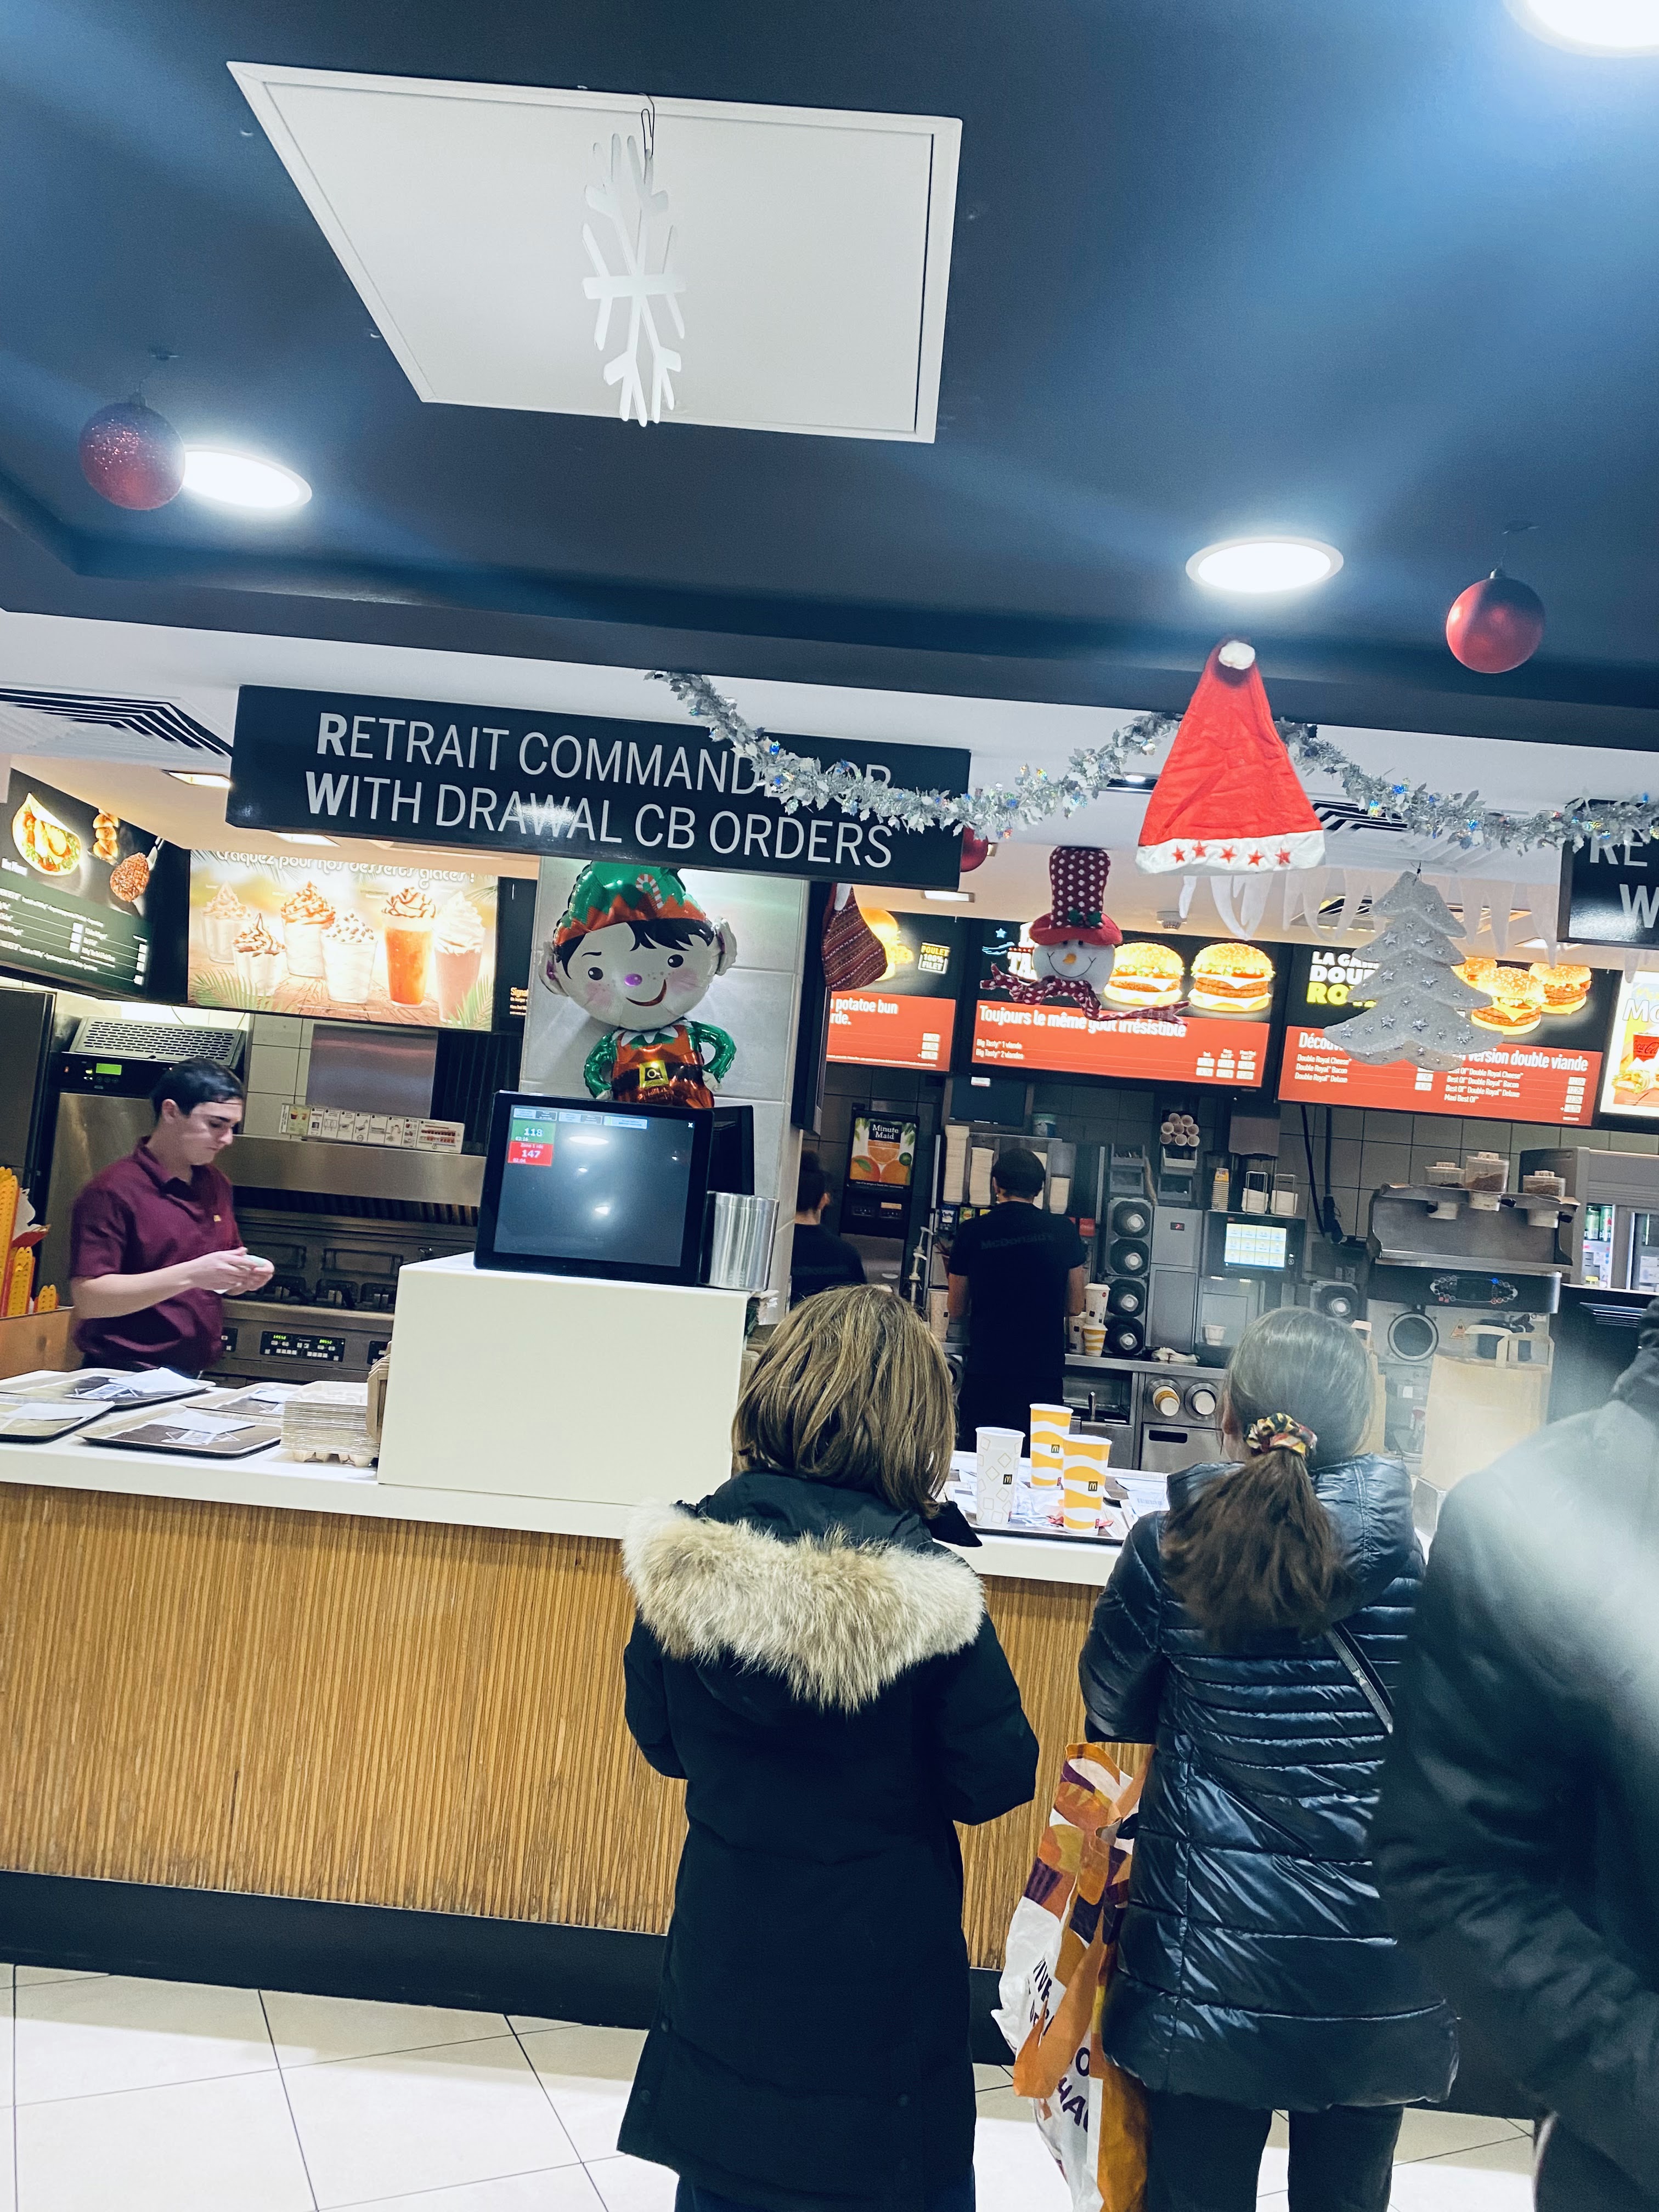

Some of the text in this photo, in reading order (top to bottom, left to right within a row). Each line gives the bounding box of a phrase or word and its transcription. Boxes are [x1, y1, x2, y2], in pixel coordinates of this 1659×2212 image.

[317, 712, 509, 771] RETRAIT
[306, 771, 893, 868] WITH DRAWAL CB ORDERS
[279, 856, 312, 869] pour
[318, 859, 342, 874] nos
[921, 945, 950, 957] POULET
[923, 953, 944, 963] 100%
[1312, 951, 1335, 966] LA
[922, 961, 943, 970] FILET
[836, 997, 876, 1013] potatoe
[878, 999, 899, 1014] bun
[979, 1005, 1032, 1026] Toujours
[1033, 1009, 1046, 1026] le
[1047, 1011, 1087, 1030] même
[977, 1039, 985, 1048] Big
[1006, 1041, 1023, 1049] viande
[975, 1048, 984, 1058] Big
[1005, 1051, 1024, 1060] viandes
[1297, 1054, 1316, 1063] Double
[1469, 1047, 1509, 1065] version
[1510, 1049, 1549, 1069] double
[1551, 1053, 1588, 1072] viande
[1296, 1063, 1314, 1071] Double
[1331, 1066, 1348, 1074] Bacon
[1469, 1068, 1487, 1076] Double
[1295, 1072, 1313, 1080] Double
[1447, 1075, 1459, 1083] Best
[1468, 1077, 1486, 1085] Double
[1503, 1080, 1519, 1088] Bacon
[1468, 1086, 1485, 1094] Double
[1502, 1089, 1520, 1097] Deluxe
[524, 1127, 543, 1137] 118
[872, 1124, 899, 1133] Minute
[875, 1131, 894, 1139] Maid
[521, 1149, 540, 1158] 147
